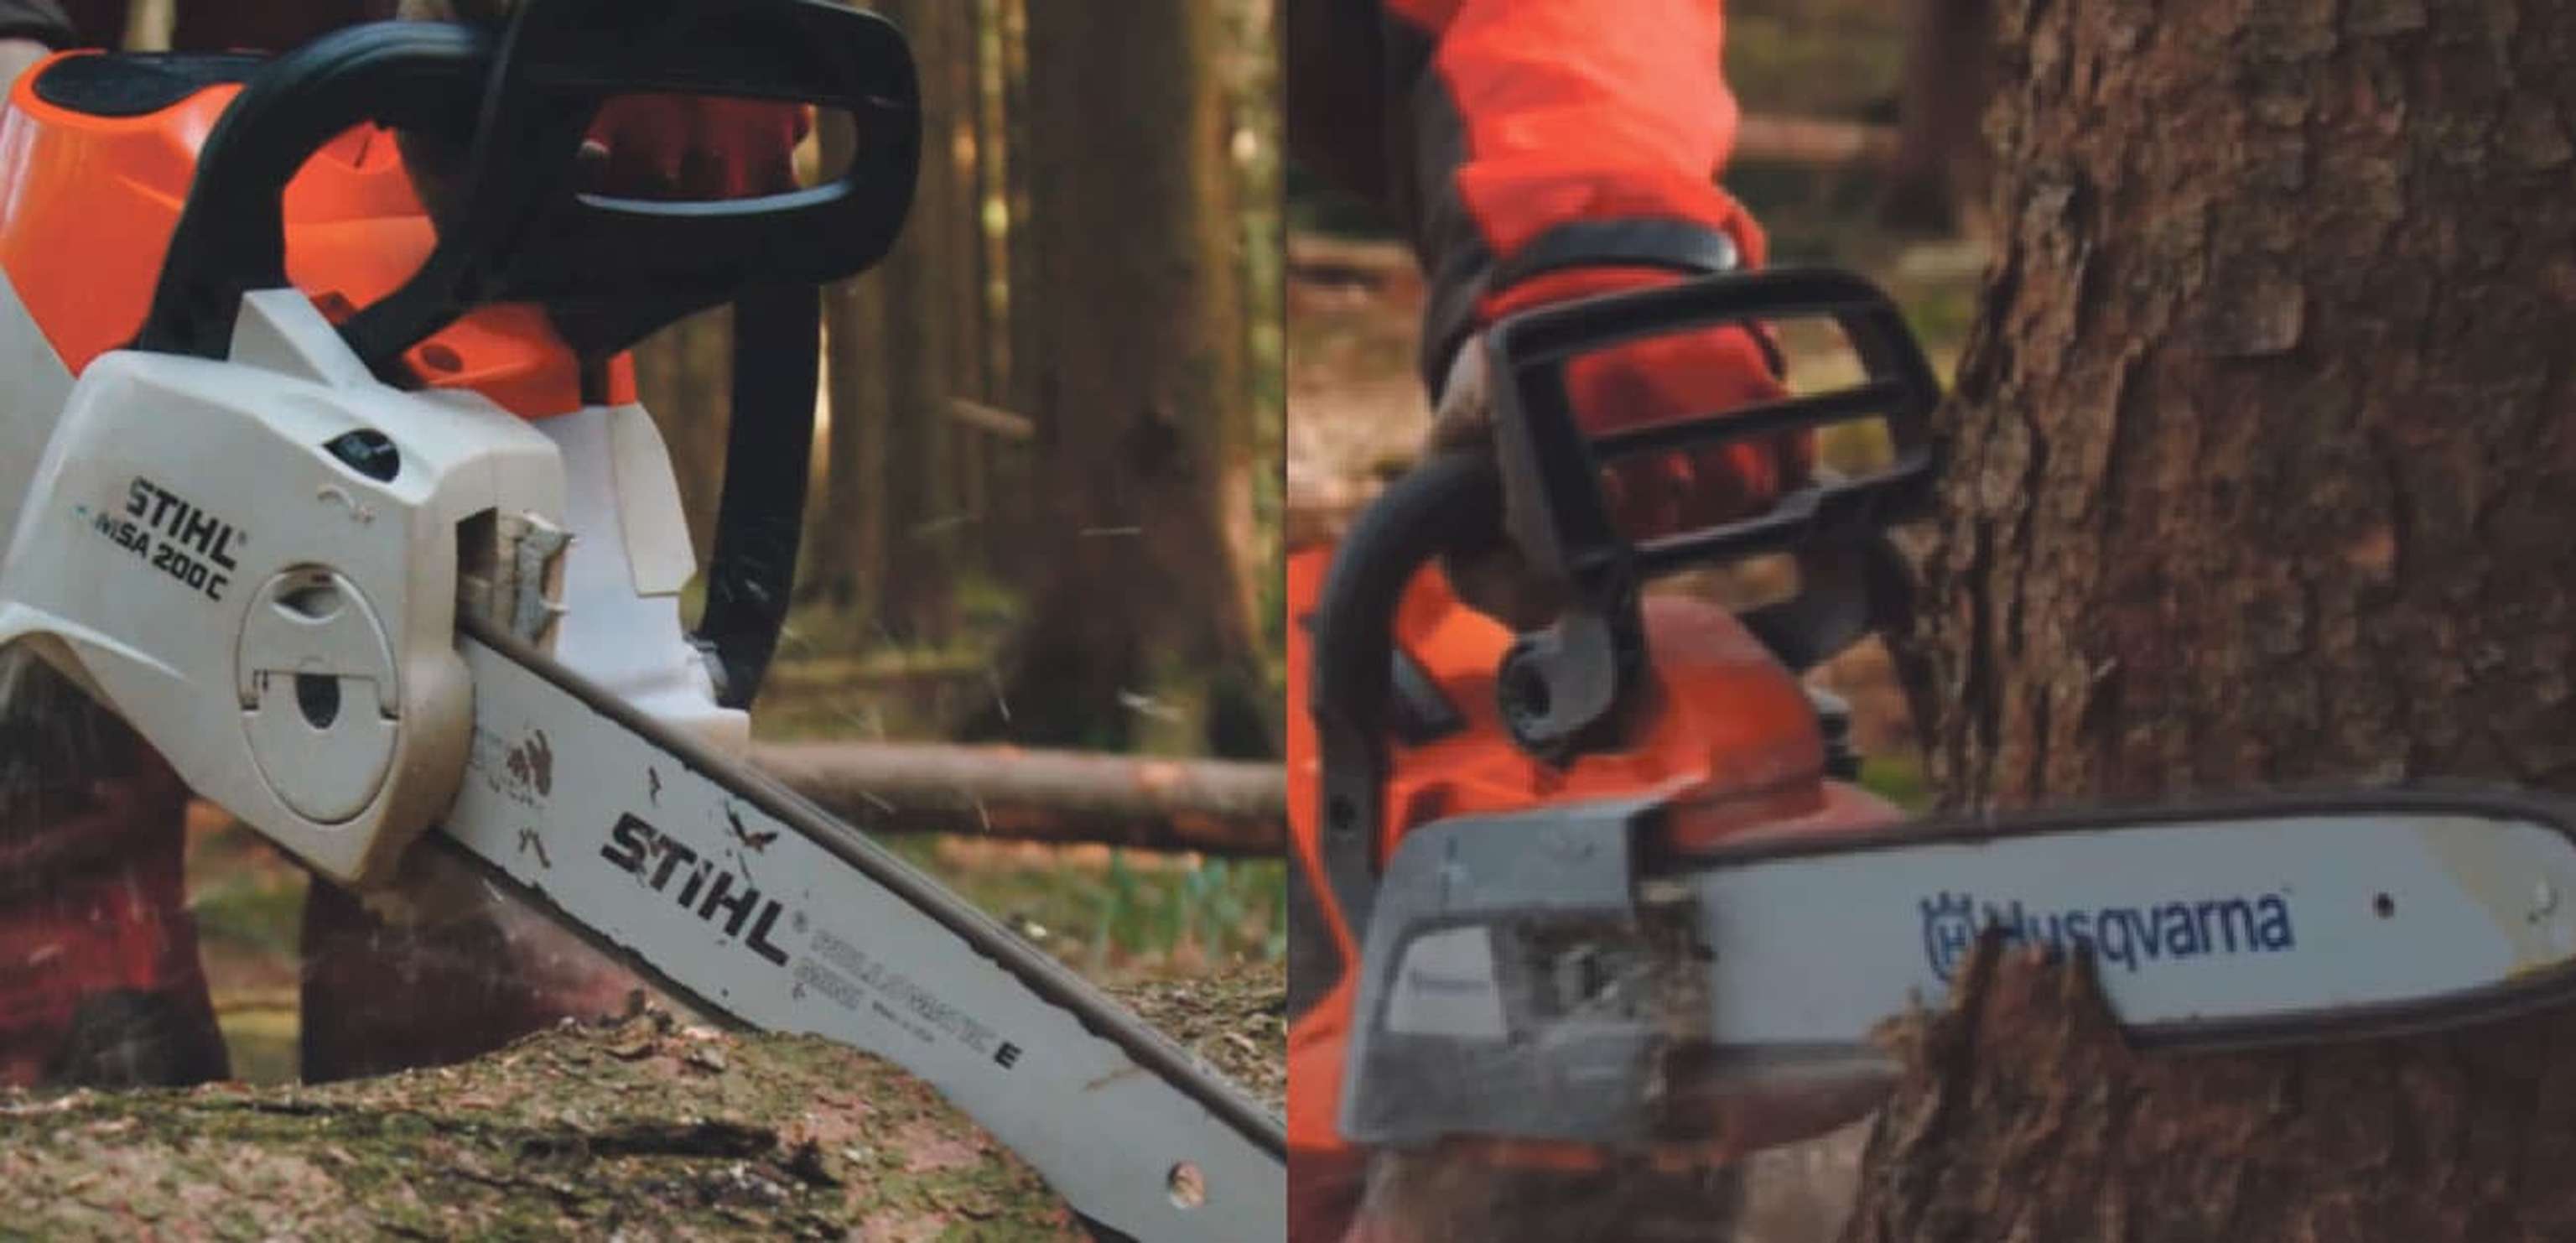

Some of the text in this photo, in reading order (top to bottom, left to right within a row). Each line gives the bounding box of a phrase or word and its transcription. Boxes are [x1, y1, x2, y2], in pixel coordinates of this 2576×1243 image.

[126, 475, 237, 572] STIHL
[151, 542, 209, 590] 200
[205, 573, 229, 602] C
[600, 811, 790, 967] STIHL
